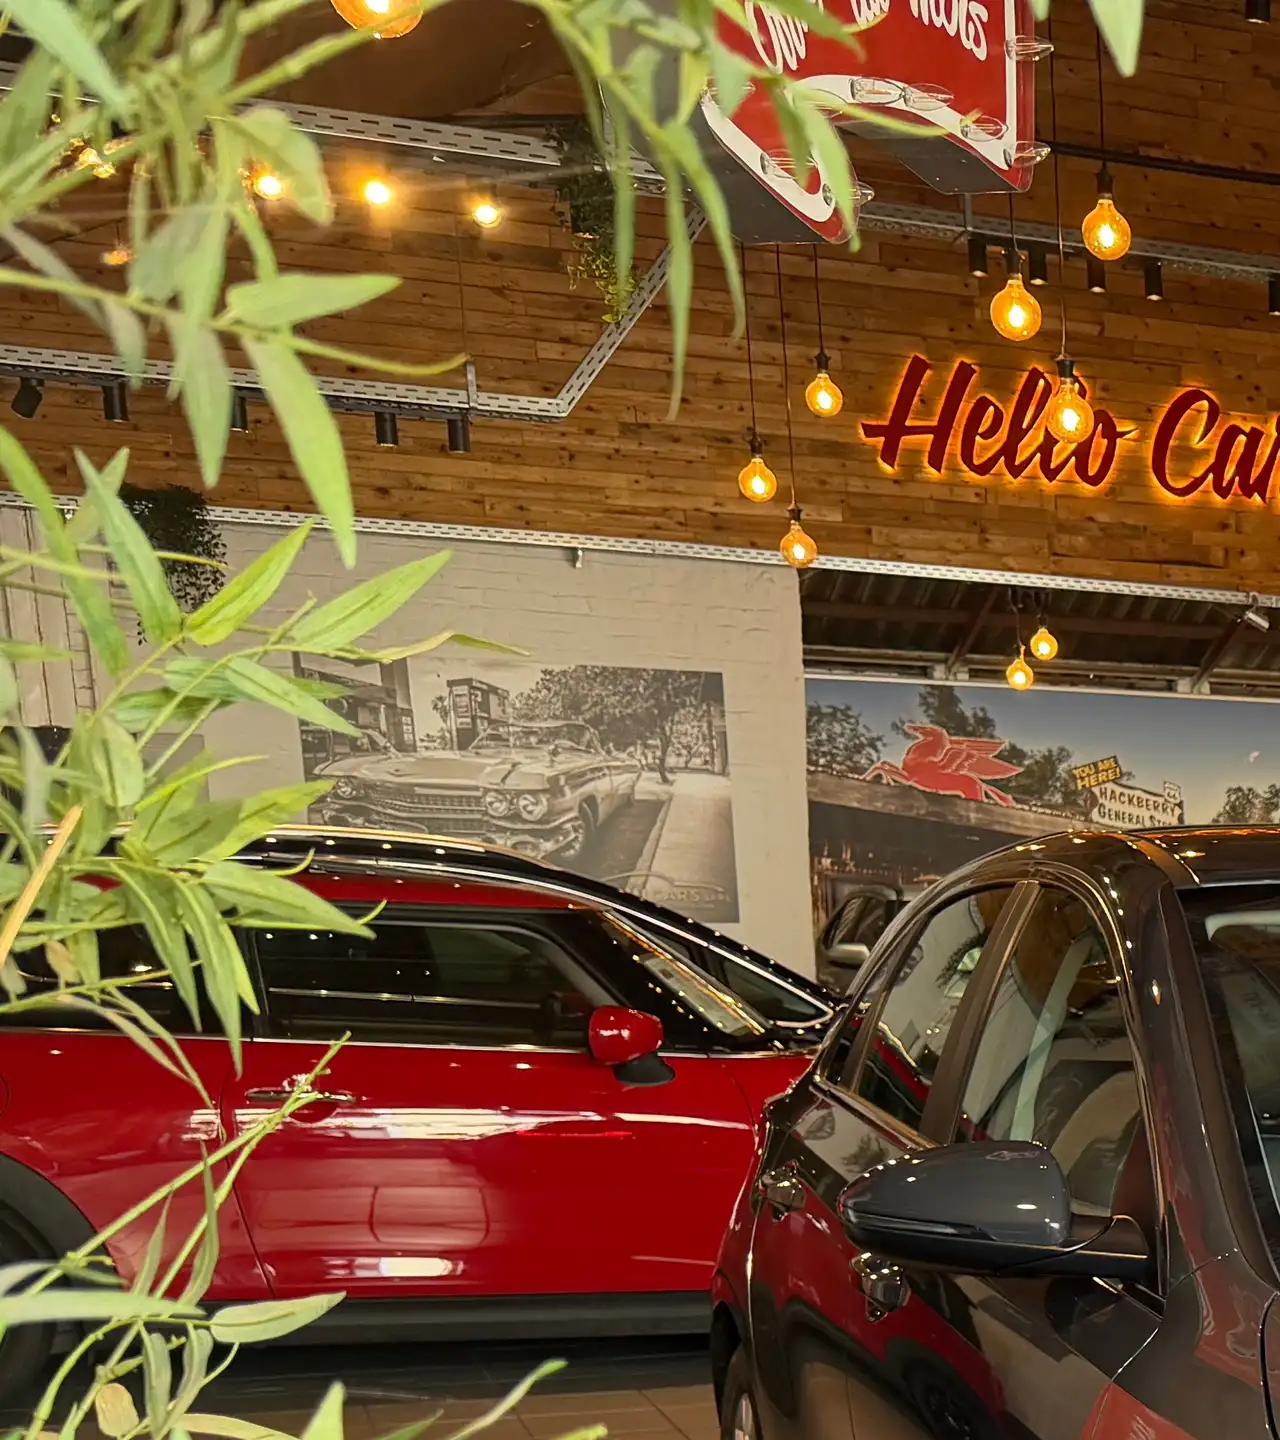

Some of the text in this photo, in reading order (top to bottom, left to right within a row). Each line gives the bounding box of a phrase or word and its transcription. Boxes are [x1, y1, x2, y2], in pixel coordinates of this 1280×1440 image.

[1072, 757, 1118, 779] YOU ARE
[1076, 766, 1121, 791] HERE!
[1099, 786, 1177, 818] HACKBERRY
